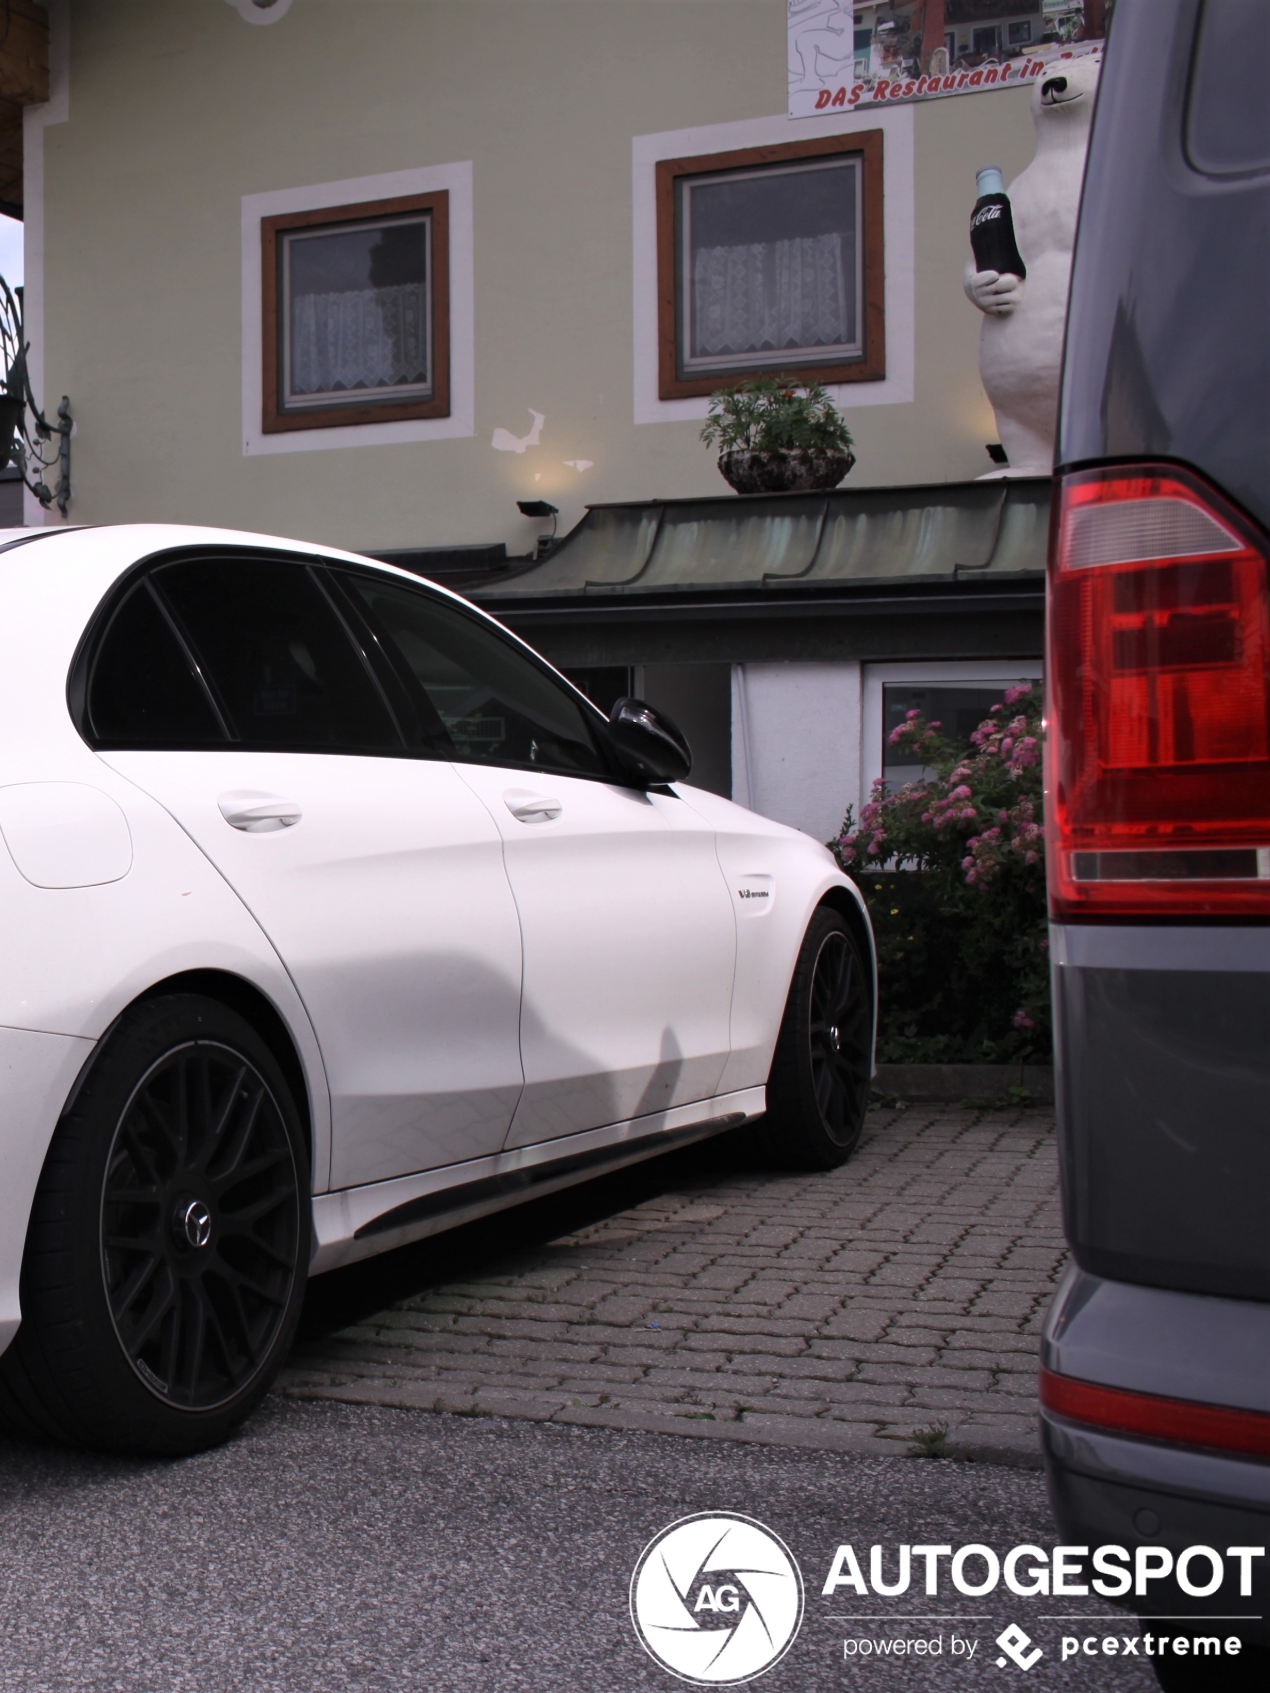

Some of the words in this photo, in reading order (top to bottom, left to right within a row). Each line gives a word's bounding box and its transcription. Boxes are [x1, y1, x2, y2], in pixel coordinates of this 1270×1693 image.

[814, 83, 865, 110] DAS
[872, 61, 1013, 102] Restaurant
[1019, 57, 1045, 80] in
